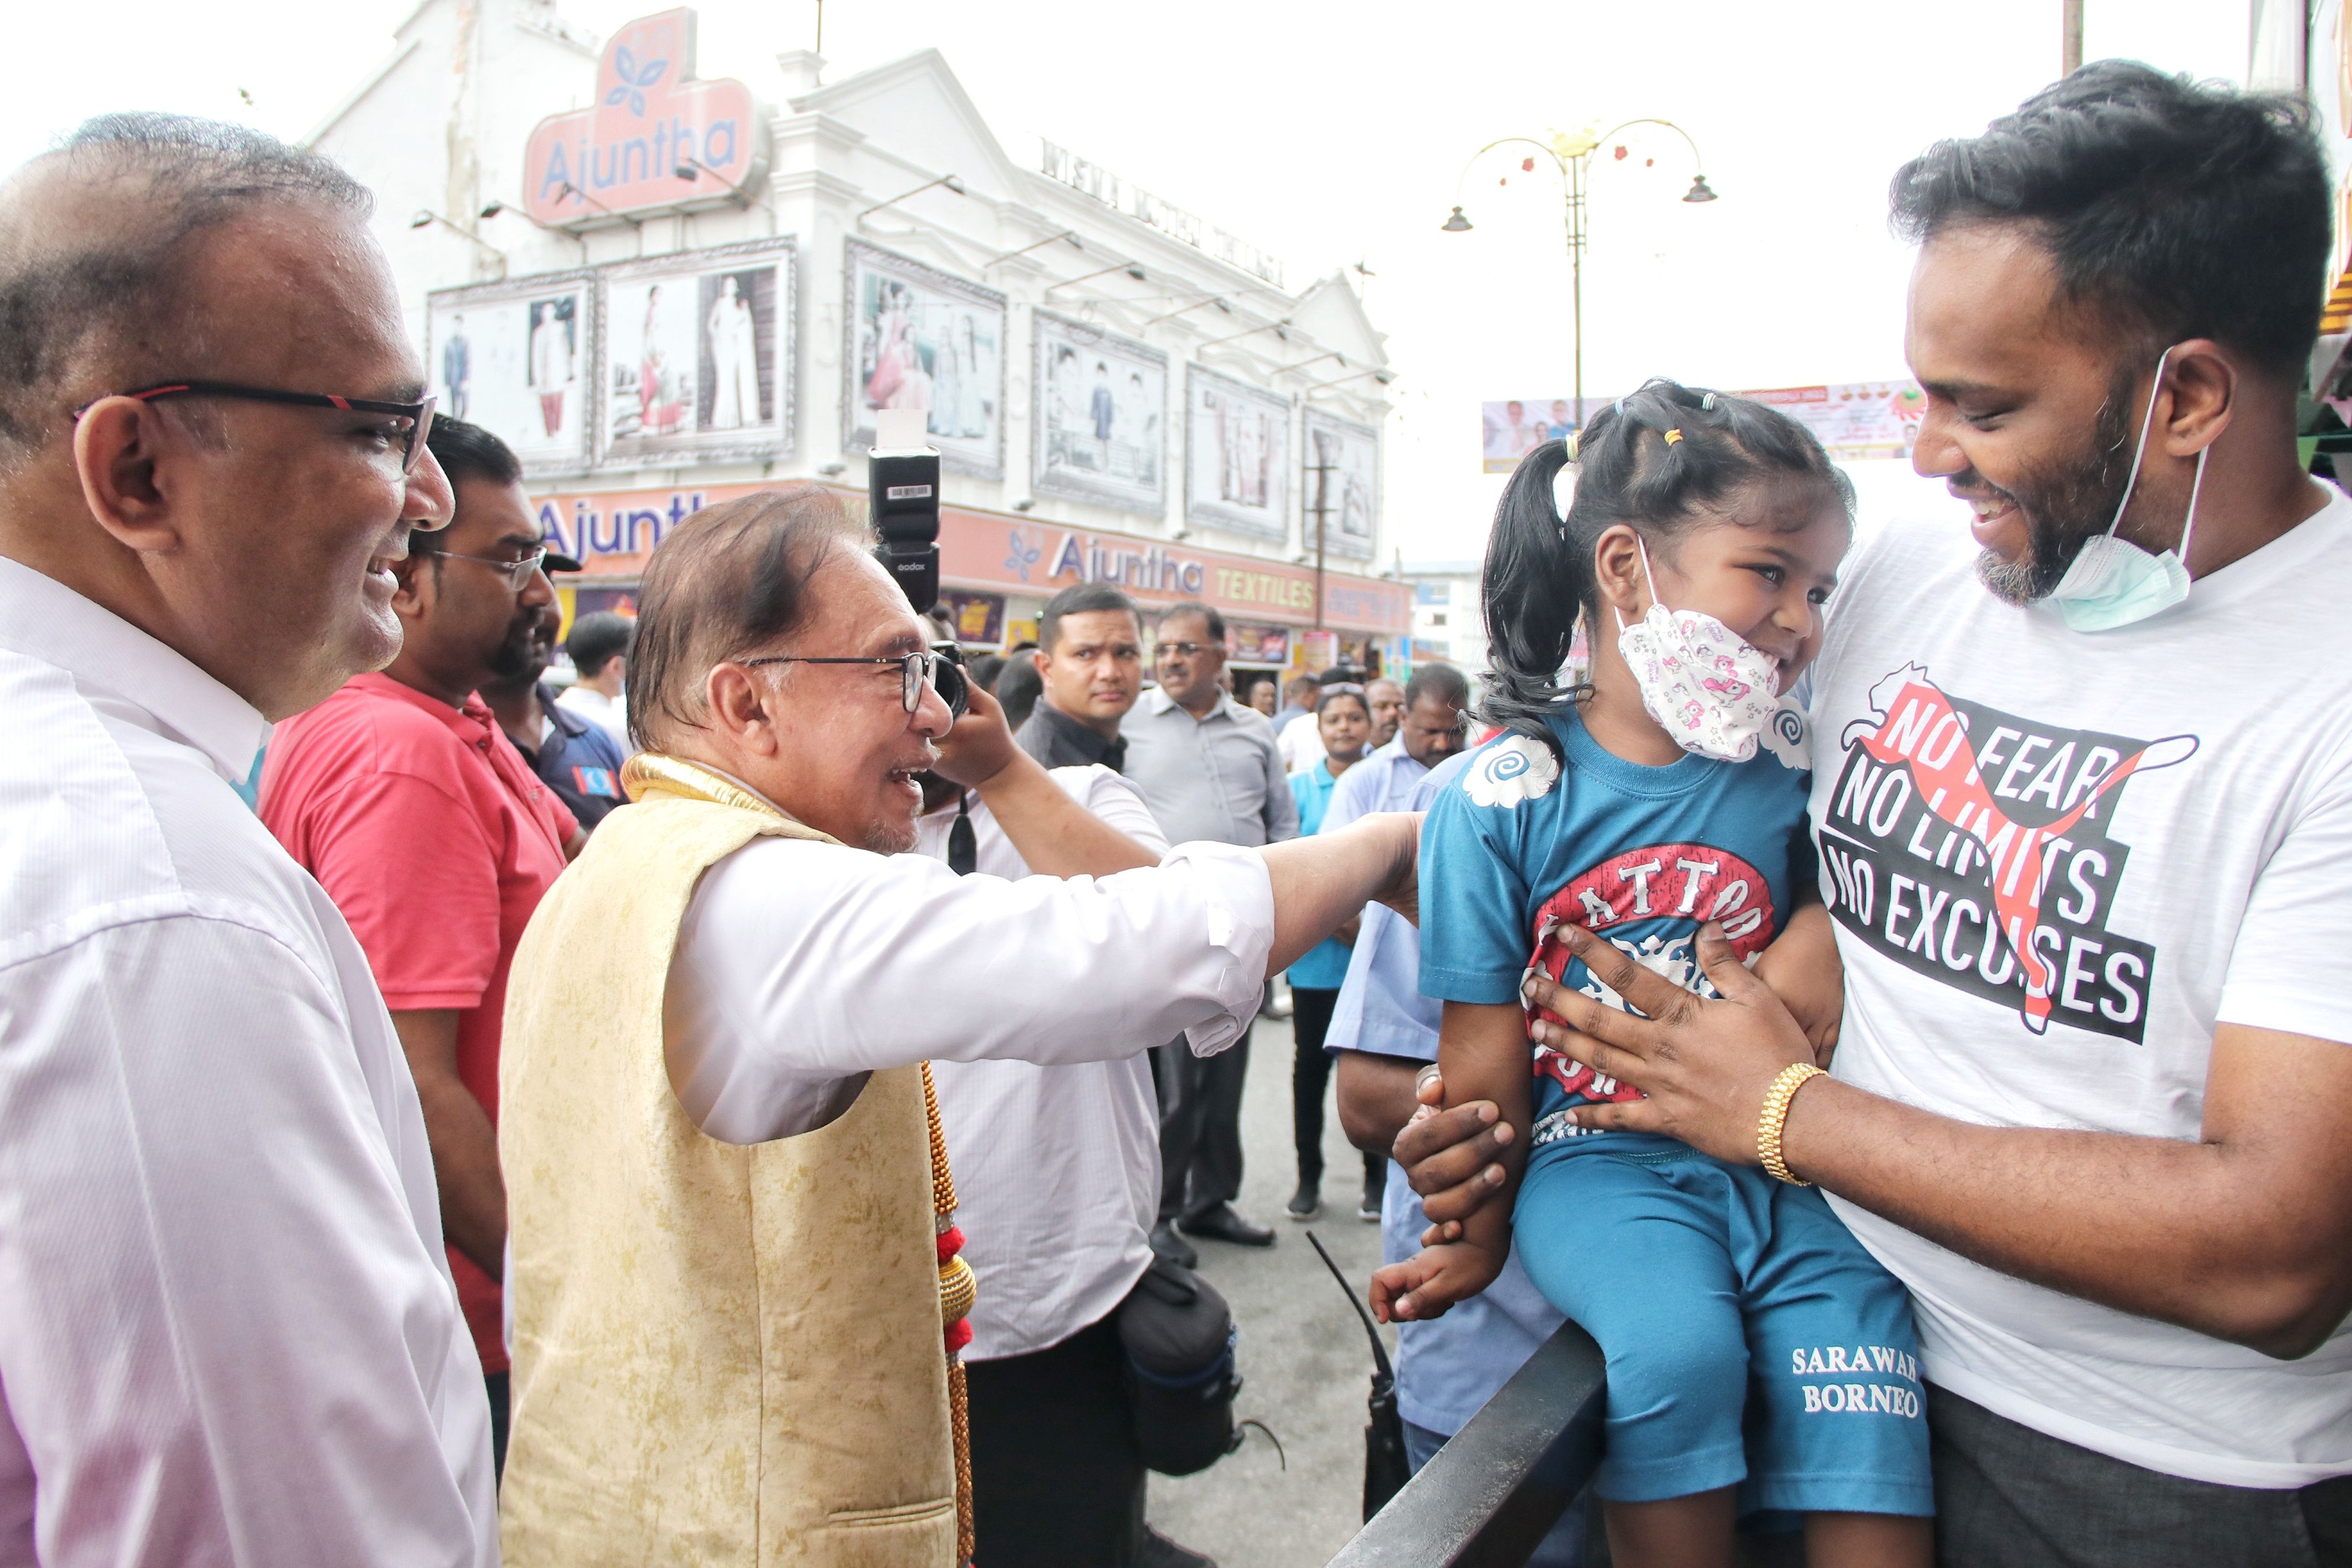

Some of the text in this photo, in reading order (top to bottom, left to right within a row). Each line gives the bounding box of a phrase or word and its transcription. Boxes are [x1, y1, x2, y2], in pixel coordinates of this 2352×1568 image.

[538, 117, 737, 205] Ajuntha
[1047, 533, 1314, 610] Ajuntha TEXTILES
[1884, 698, 2121, 819] NO FEAR
[1837, 756, 2107, 925] NO LIMITS
[1827, 844, 2146, 1024] NO EXCUSES
[1792, 1345, 1916, 1383] SARAWAK
[1802, 1384, 1918, 1419] BORNEO
